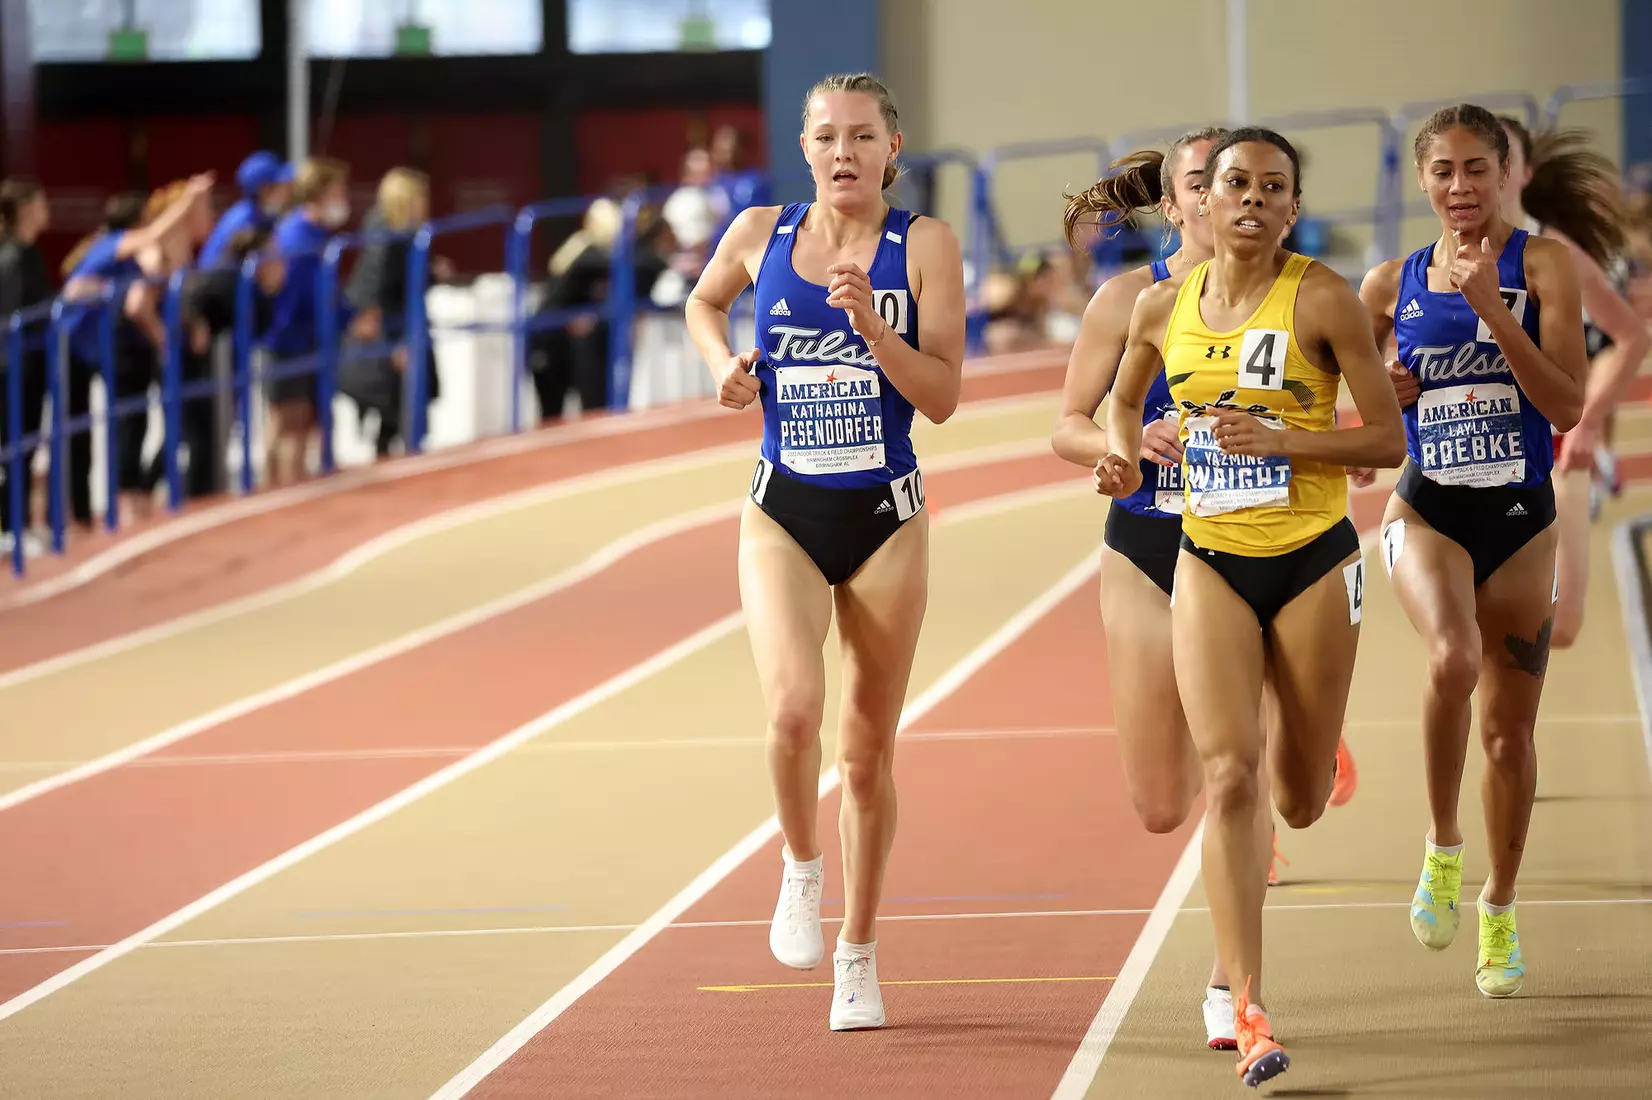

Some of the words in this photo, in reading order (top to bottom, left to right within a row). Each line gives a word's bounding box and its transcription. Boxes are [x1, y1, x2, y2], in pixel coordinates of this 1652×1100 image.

[769, 309, 792, 317] adidas
[1400, 309, 1424, 321] adidas
[1246, 333, 1276, 386] 4
[781, 380, 873, 400] AMERICAN
[791, 401, 867, 419] KATHARINA
[1421, 398, 1513, 423] AMERICAN
[780, 415, 883, 447] PESENDORFER
[1448, 420, 1490, 437] LAYLA
[1204, 451, 1265, 467] YAZMINE
[1421, 431, 1523, 468] ROEBKE
[1188, 464, 1290, 490] WRIGHT
[901, 469, 924, 514] 10
